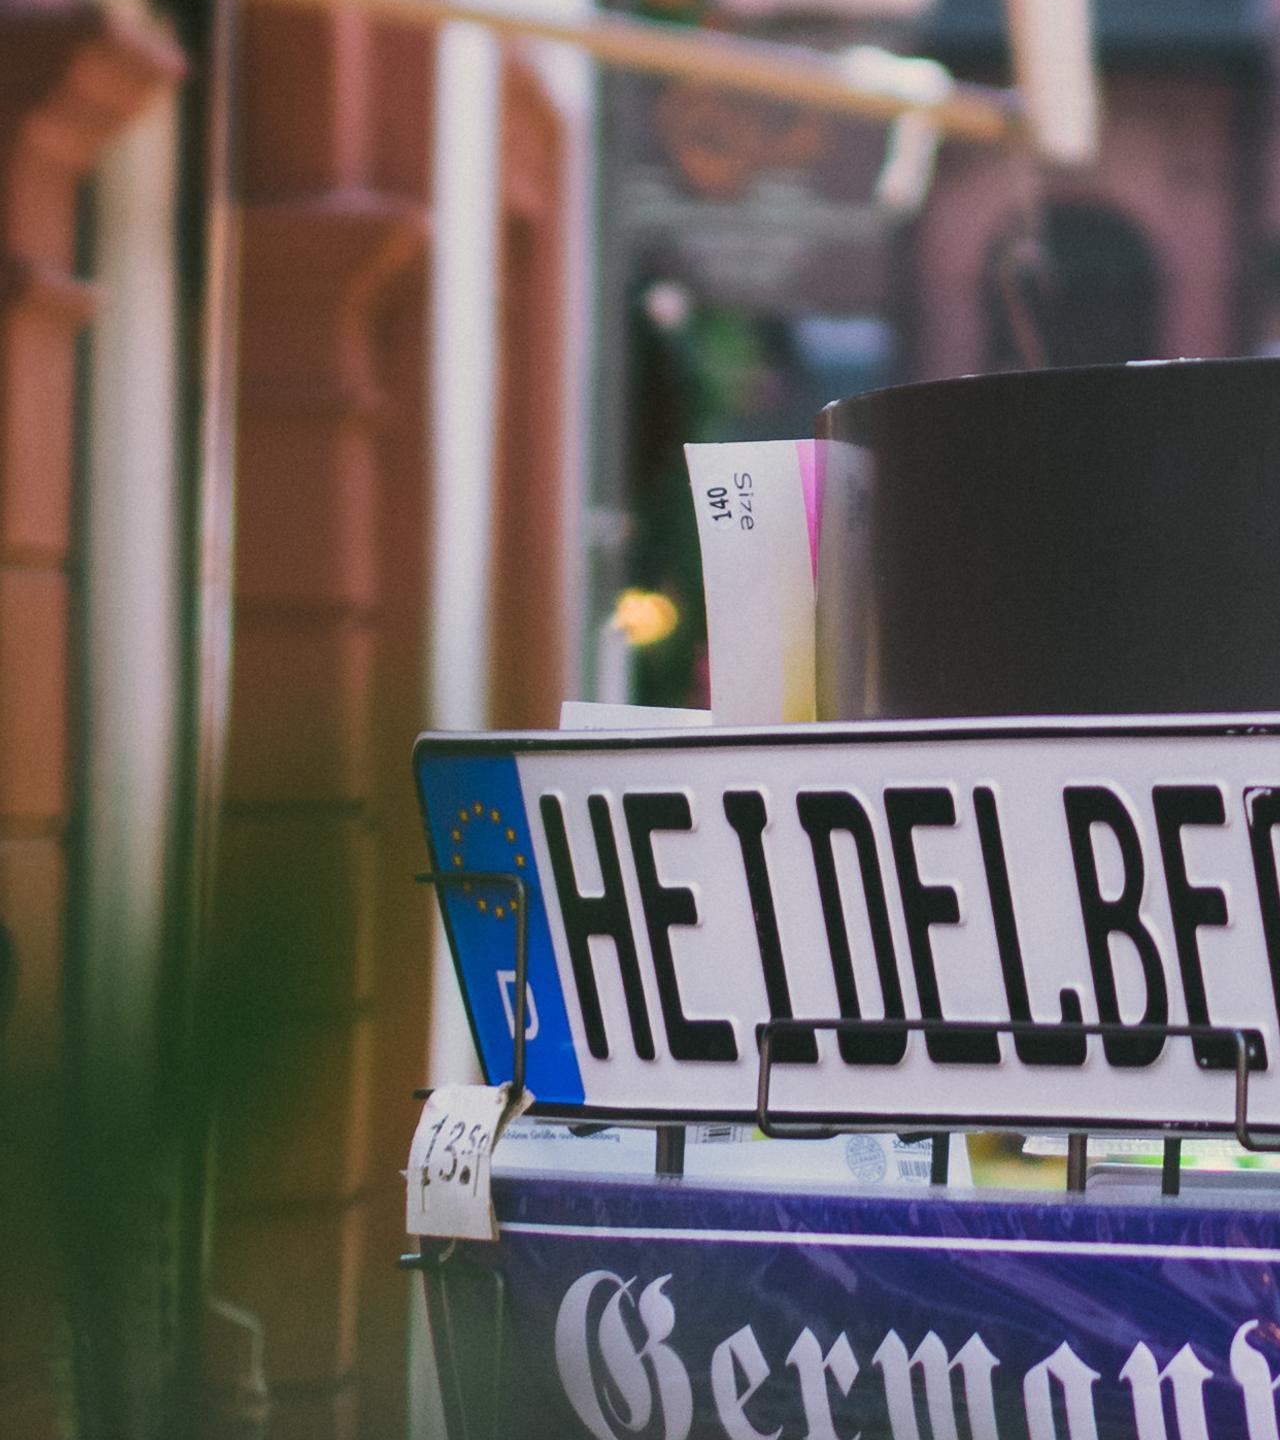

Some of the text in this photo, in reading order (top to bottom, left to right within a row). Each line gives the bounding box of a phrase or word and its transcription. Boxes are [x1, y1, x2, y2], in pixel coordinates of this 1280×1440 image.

[706, 486, 733, 522] 140
[733, 472, 755, 531] Size
[495, 968, 541, 1042] D
